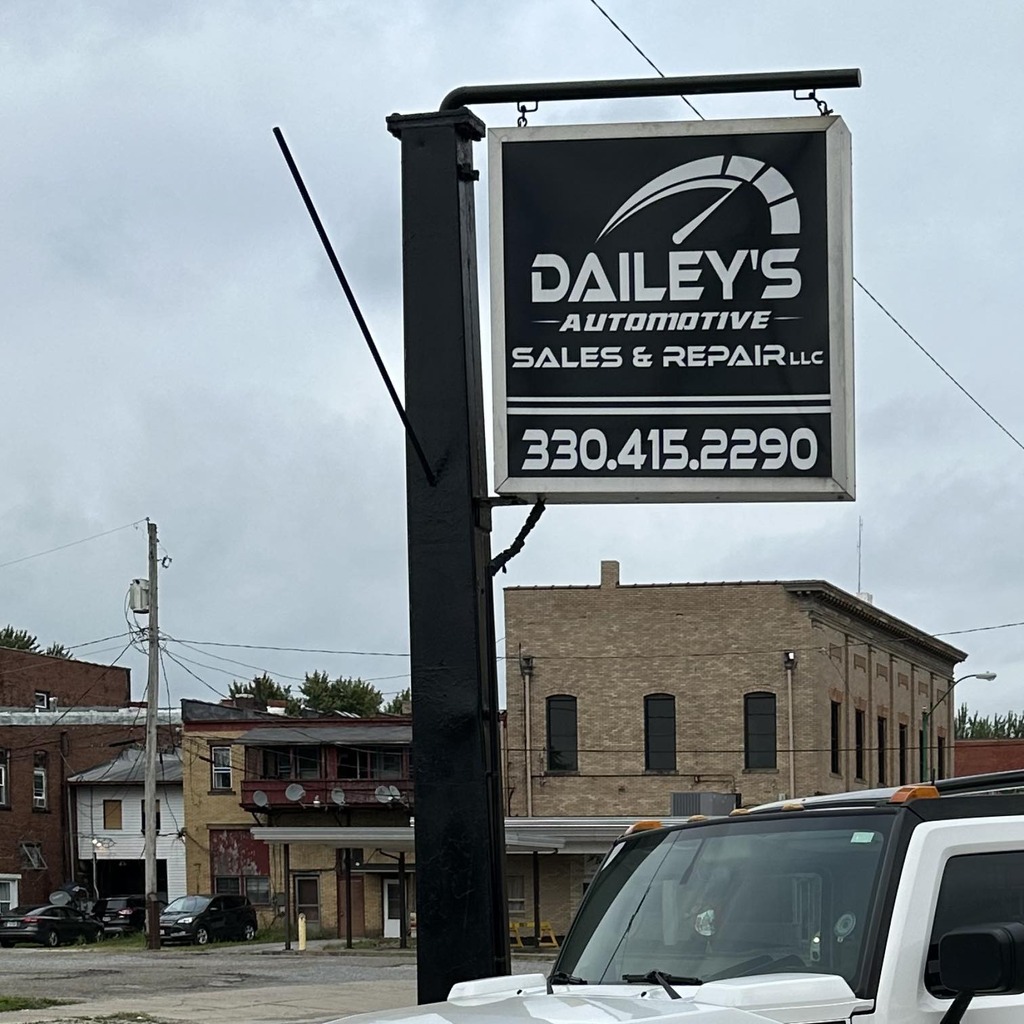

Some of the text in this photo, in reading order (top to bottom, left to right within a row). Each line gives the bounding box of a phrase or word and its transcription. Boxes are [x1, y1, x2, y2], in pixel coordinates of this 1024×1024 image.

[532, 248, 802, 302] DAILEY'S
[559, 310, 772, 332] AUTOMOTIVE
[511, 344, 824, 368] SALES & REPAIR LLC
[521, 427, 818, 471] 330.415.2290
